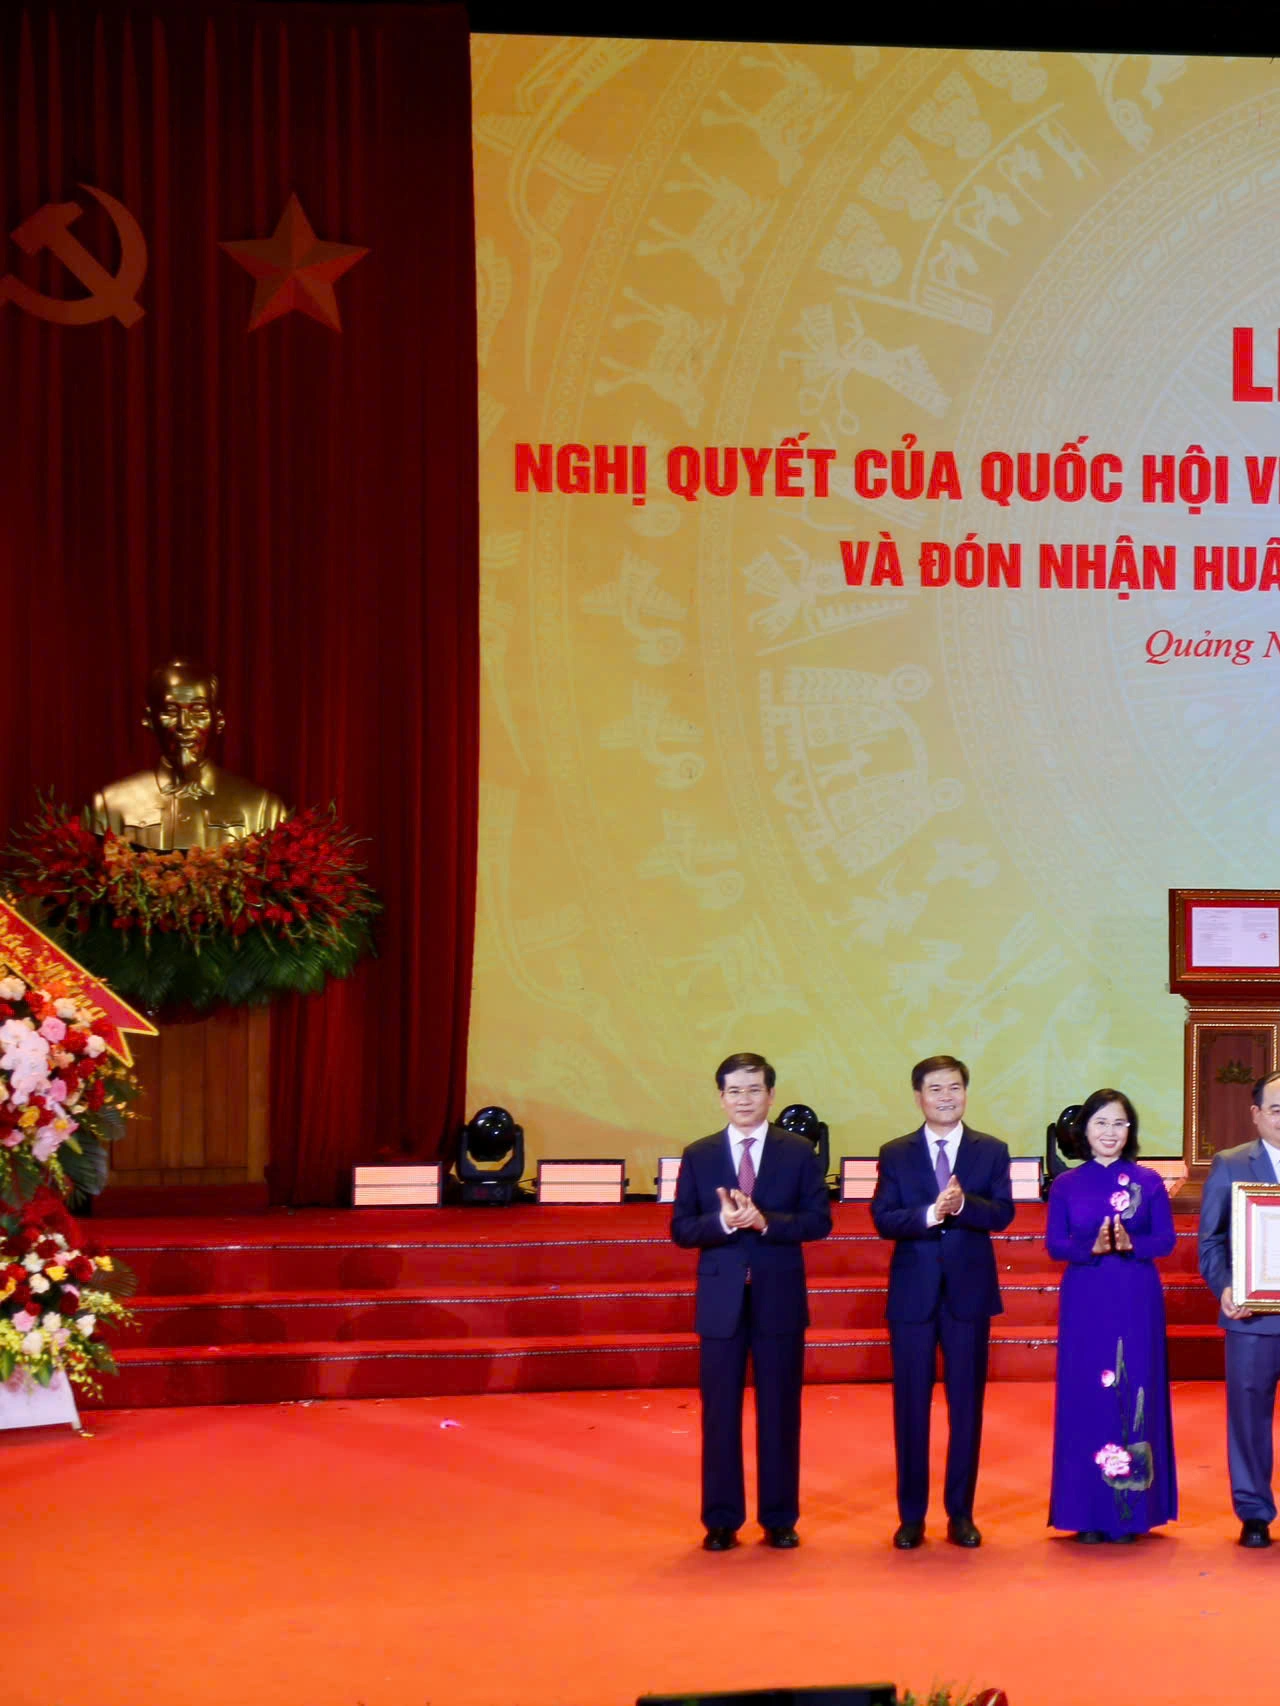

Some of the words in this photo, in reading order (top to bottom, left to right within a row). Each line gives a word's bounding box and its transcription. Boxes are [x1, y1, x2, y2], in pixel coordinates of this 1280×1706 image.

[514, 443, 647, 507] NGHỊ
[667, 432, 837, 503] QUYẾT
[855, 433, 962, 501] CỦA
[982, 435, 1123, 508] QUỐC
[1143, 446, 1229, 516] HỘI
[840, 531, 904, 588] VÀ
[919, 532, 1022, 589] ĐÓN
[1040, 535, 1176, 601] NHẬN
[1145, 629, 1255, 666] Quảng
